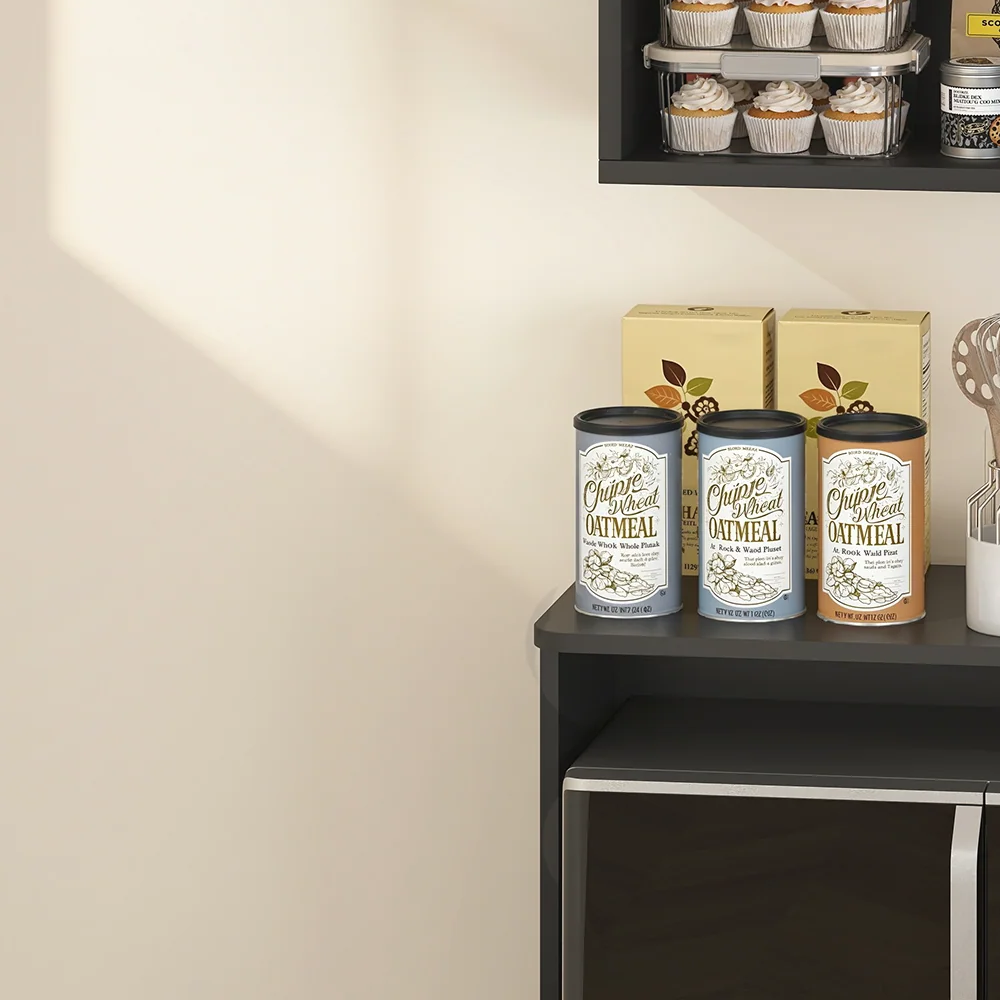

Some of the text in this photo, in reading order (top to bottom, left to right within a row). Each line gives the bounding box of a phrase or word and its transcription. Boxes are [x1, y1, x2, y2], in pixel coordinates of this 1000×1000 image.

[608, 484, 660, 516] Wheat
[731, 489, 784, 520] Wheat
[852, 492, 906, 524] Wheat
[585, 513, 658, 539] OATMEAL
[708, 517, 782, 543] OATMEAL
[828, 520, 905, 546] OATMEAL
[718, 543, 734, 552] Rock
